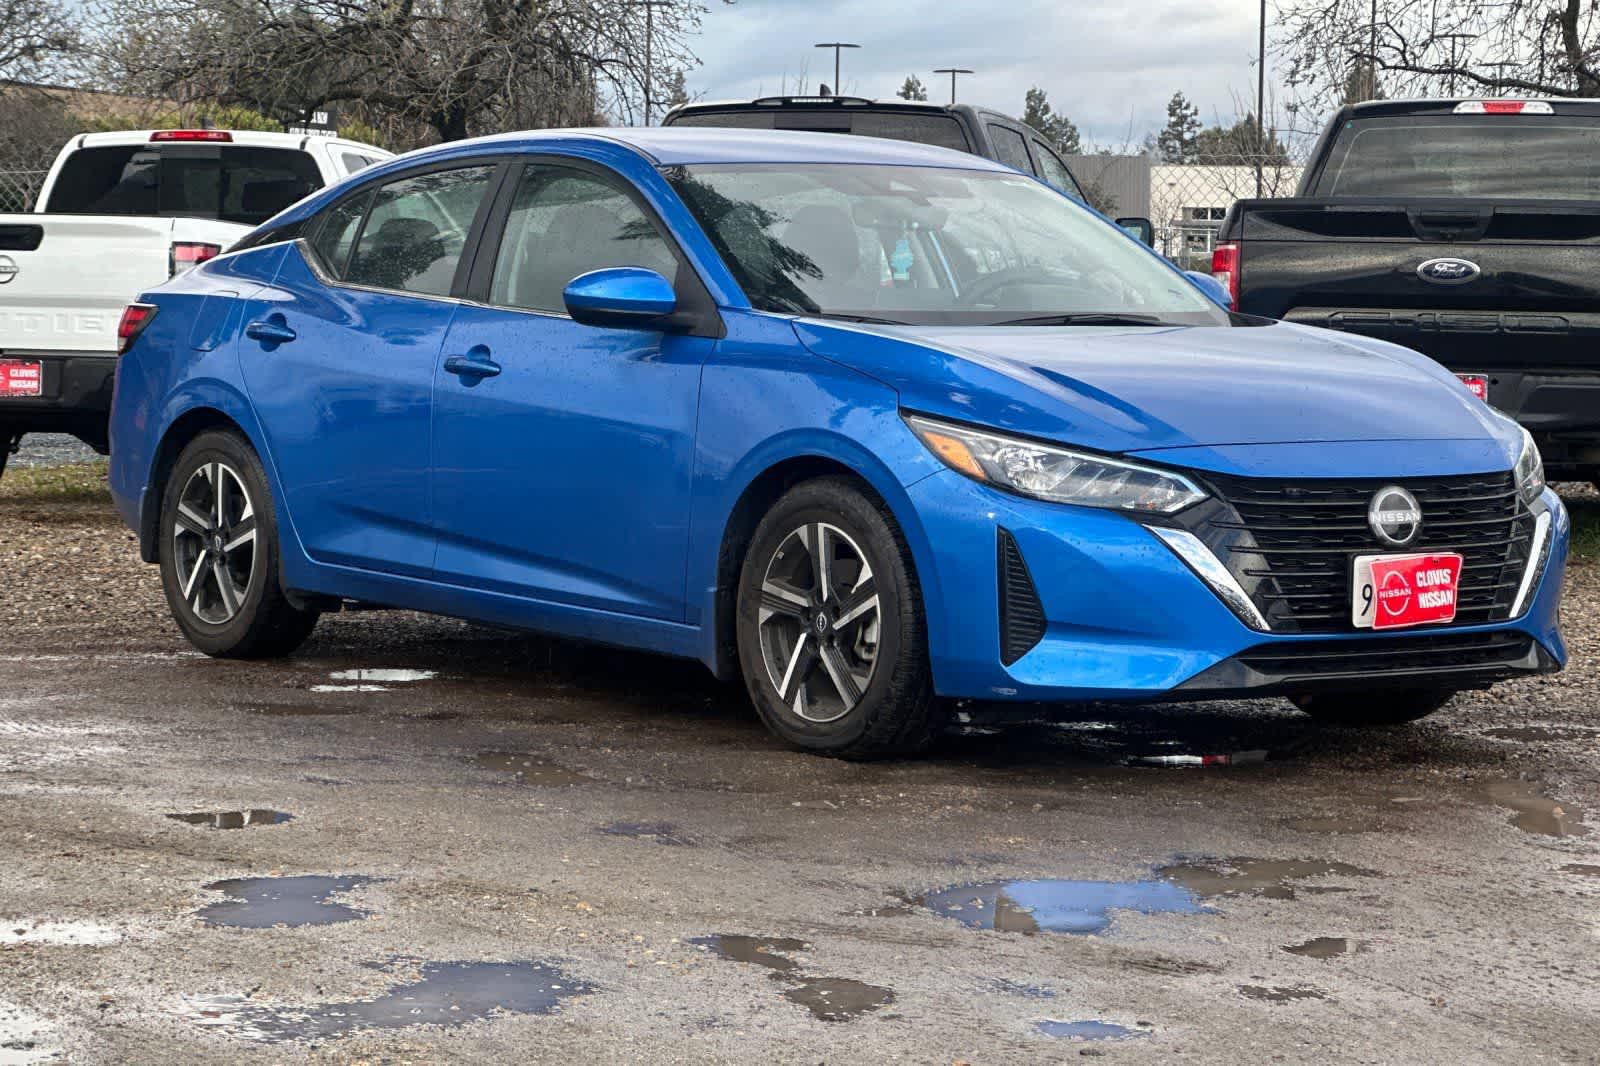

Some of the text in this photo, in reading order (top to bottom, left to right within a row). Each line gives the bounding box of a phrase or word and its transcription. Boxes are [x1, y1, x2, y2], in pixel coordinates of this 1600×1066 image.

[1432, 262, 1466, 277] Ford
[1370, 511, 1420, 522] NISSAN
[1416, 568, 1452, 588] CLOVIS
[1361, 583, 1373, 616] 9
[1379, 588, 1412, 598] NISSAN
[1418, 589, 1454, 609] NISSAN
